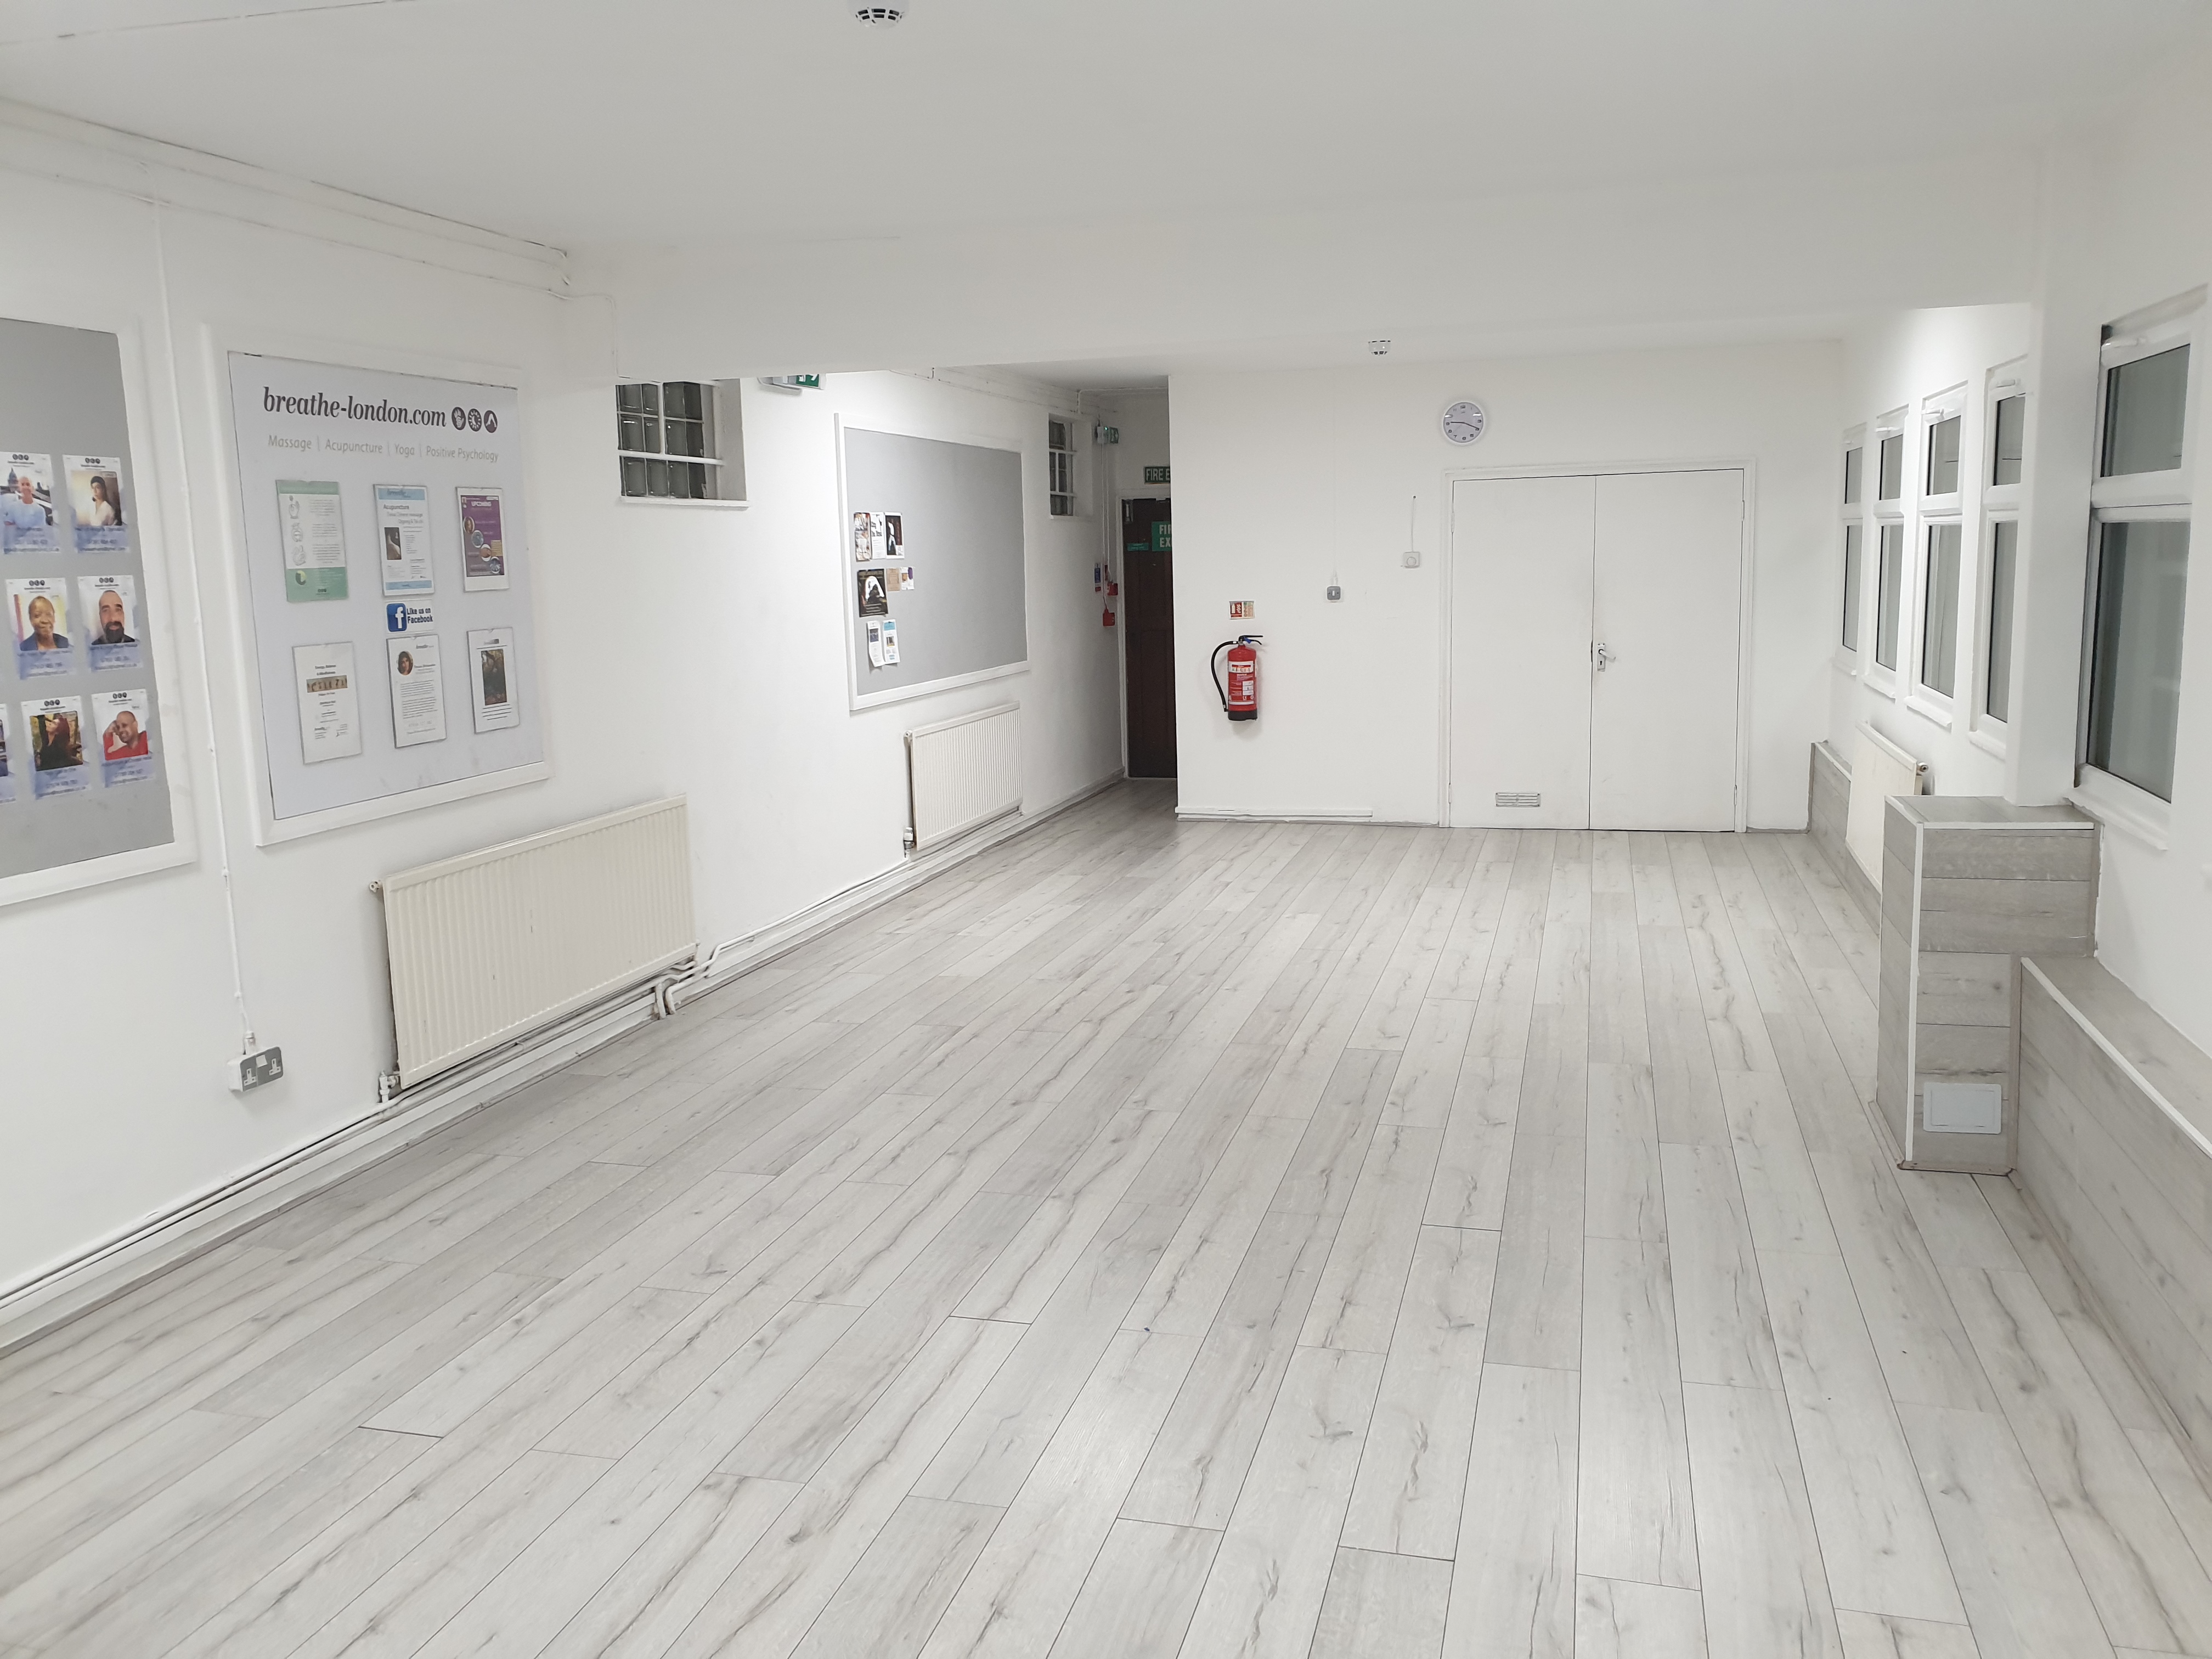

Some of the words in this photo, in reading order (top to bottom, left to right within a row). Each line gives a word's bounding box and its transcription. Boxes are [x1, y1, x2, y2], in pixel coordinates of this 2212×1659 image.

[263, 386, 447, 427] breathe-london.com
[268, 435, 312, 452] Massage
[325, 439, 383, 454] Acupuncture
[394, 443, 415, 458] Yoga
[426, 445, 455, 458] Positive
[458, 448, 499, 463] Psychology
[1146, 469, 1164, 481] FIRE
[1159, 524, 1172, 535] FIR
[1159, 537, 1172, 548] EX
[407, 614, 433, 624] Facebook
